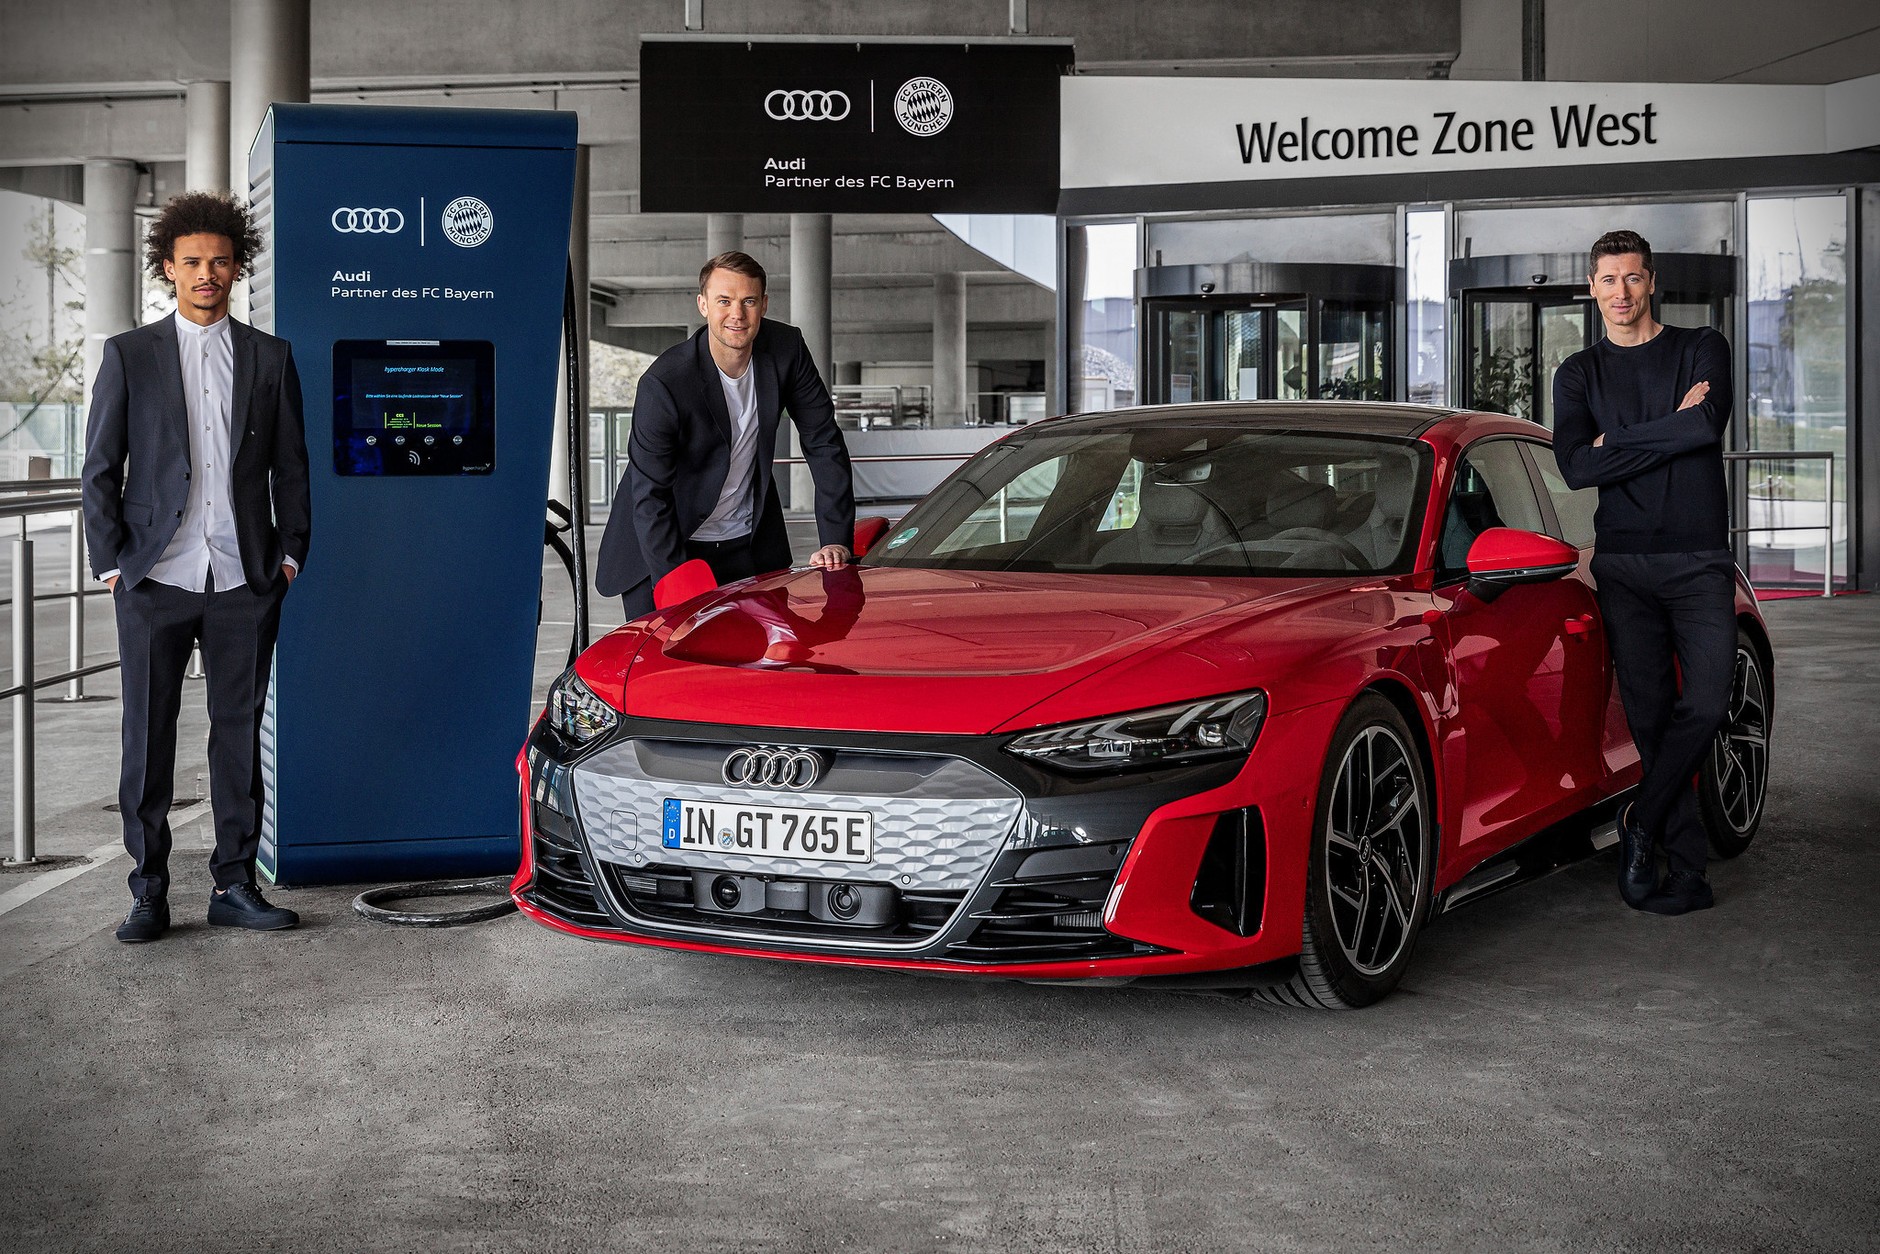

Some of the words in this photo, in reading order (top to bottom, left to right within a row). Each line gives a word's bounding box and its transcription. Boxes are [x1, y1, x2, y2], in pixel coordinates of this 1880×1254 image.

[899, 89, 911, 102] FC
[911, 81, 948, 102] BAYERN
[1235, 116, 1419, 164] Welcome
[1431, 111, 1534, 155] Zone
[1550, 102, 1657, 149] West
[763, 157, 806, 170] Audi
[764, 174, 831, 187] Partner
[834, 175, 865, 188] des
[870, 175, 891, 188] FC
[896, 175, 955, 191] Bayern
[446, 206, 457, 219] FC
[456, 200, 489, 219] BAYERN
[331, 270, 371, 282] Audi
[331, 286, 388, 298] Partner
[391, 287, 418, 298] des
[422, 287, 440, 299] FC
[444, 287, 494, 301] Bayern
[668, 828, 676, 840] D
[683, 806, 715, 846] IN
[736, 811, 773, 850] GT
